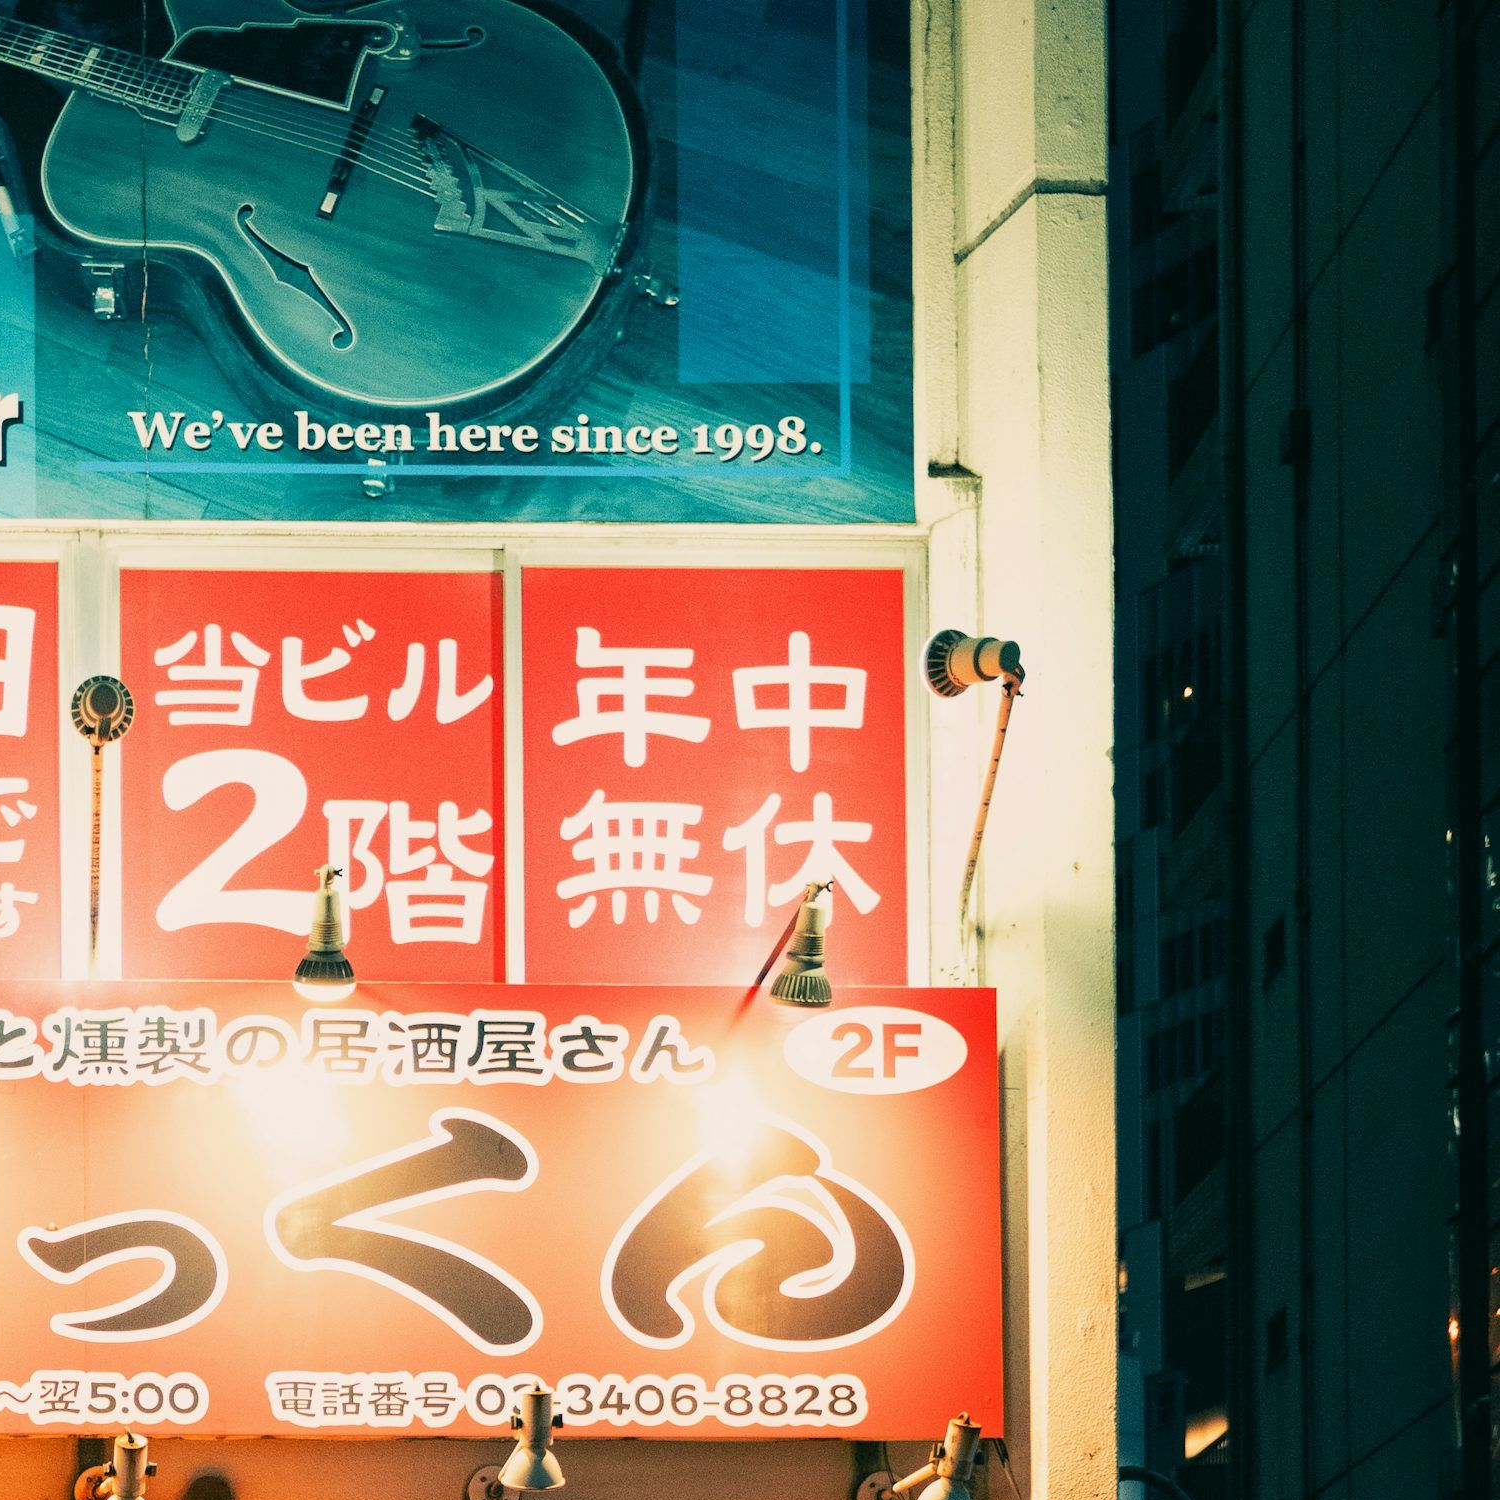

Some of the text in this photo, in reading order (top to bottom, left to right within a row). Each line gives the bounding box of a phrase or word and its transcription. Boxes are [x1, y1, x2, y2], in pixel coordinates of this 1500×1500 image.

[298, 411, 413, 453] been
[426, 412, 537, 454] here
[551, 414, 678, 456] since
[691, 417, 822, 462] 1998.
[154, 618, 494, 726] 当ビル
[551, 625, 868, 772] 年中
[155, 748, 494, 945] 2階
[557, 790, 882, 928] 無休
[830, 1022, 923, 1078] 2F
[275, 1379, 457, 1418] 電話番号
